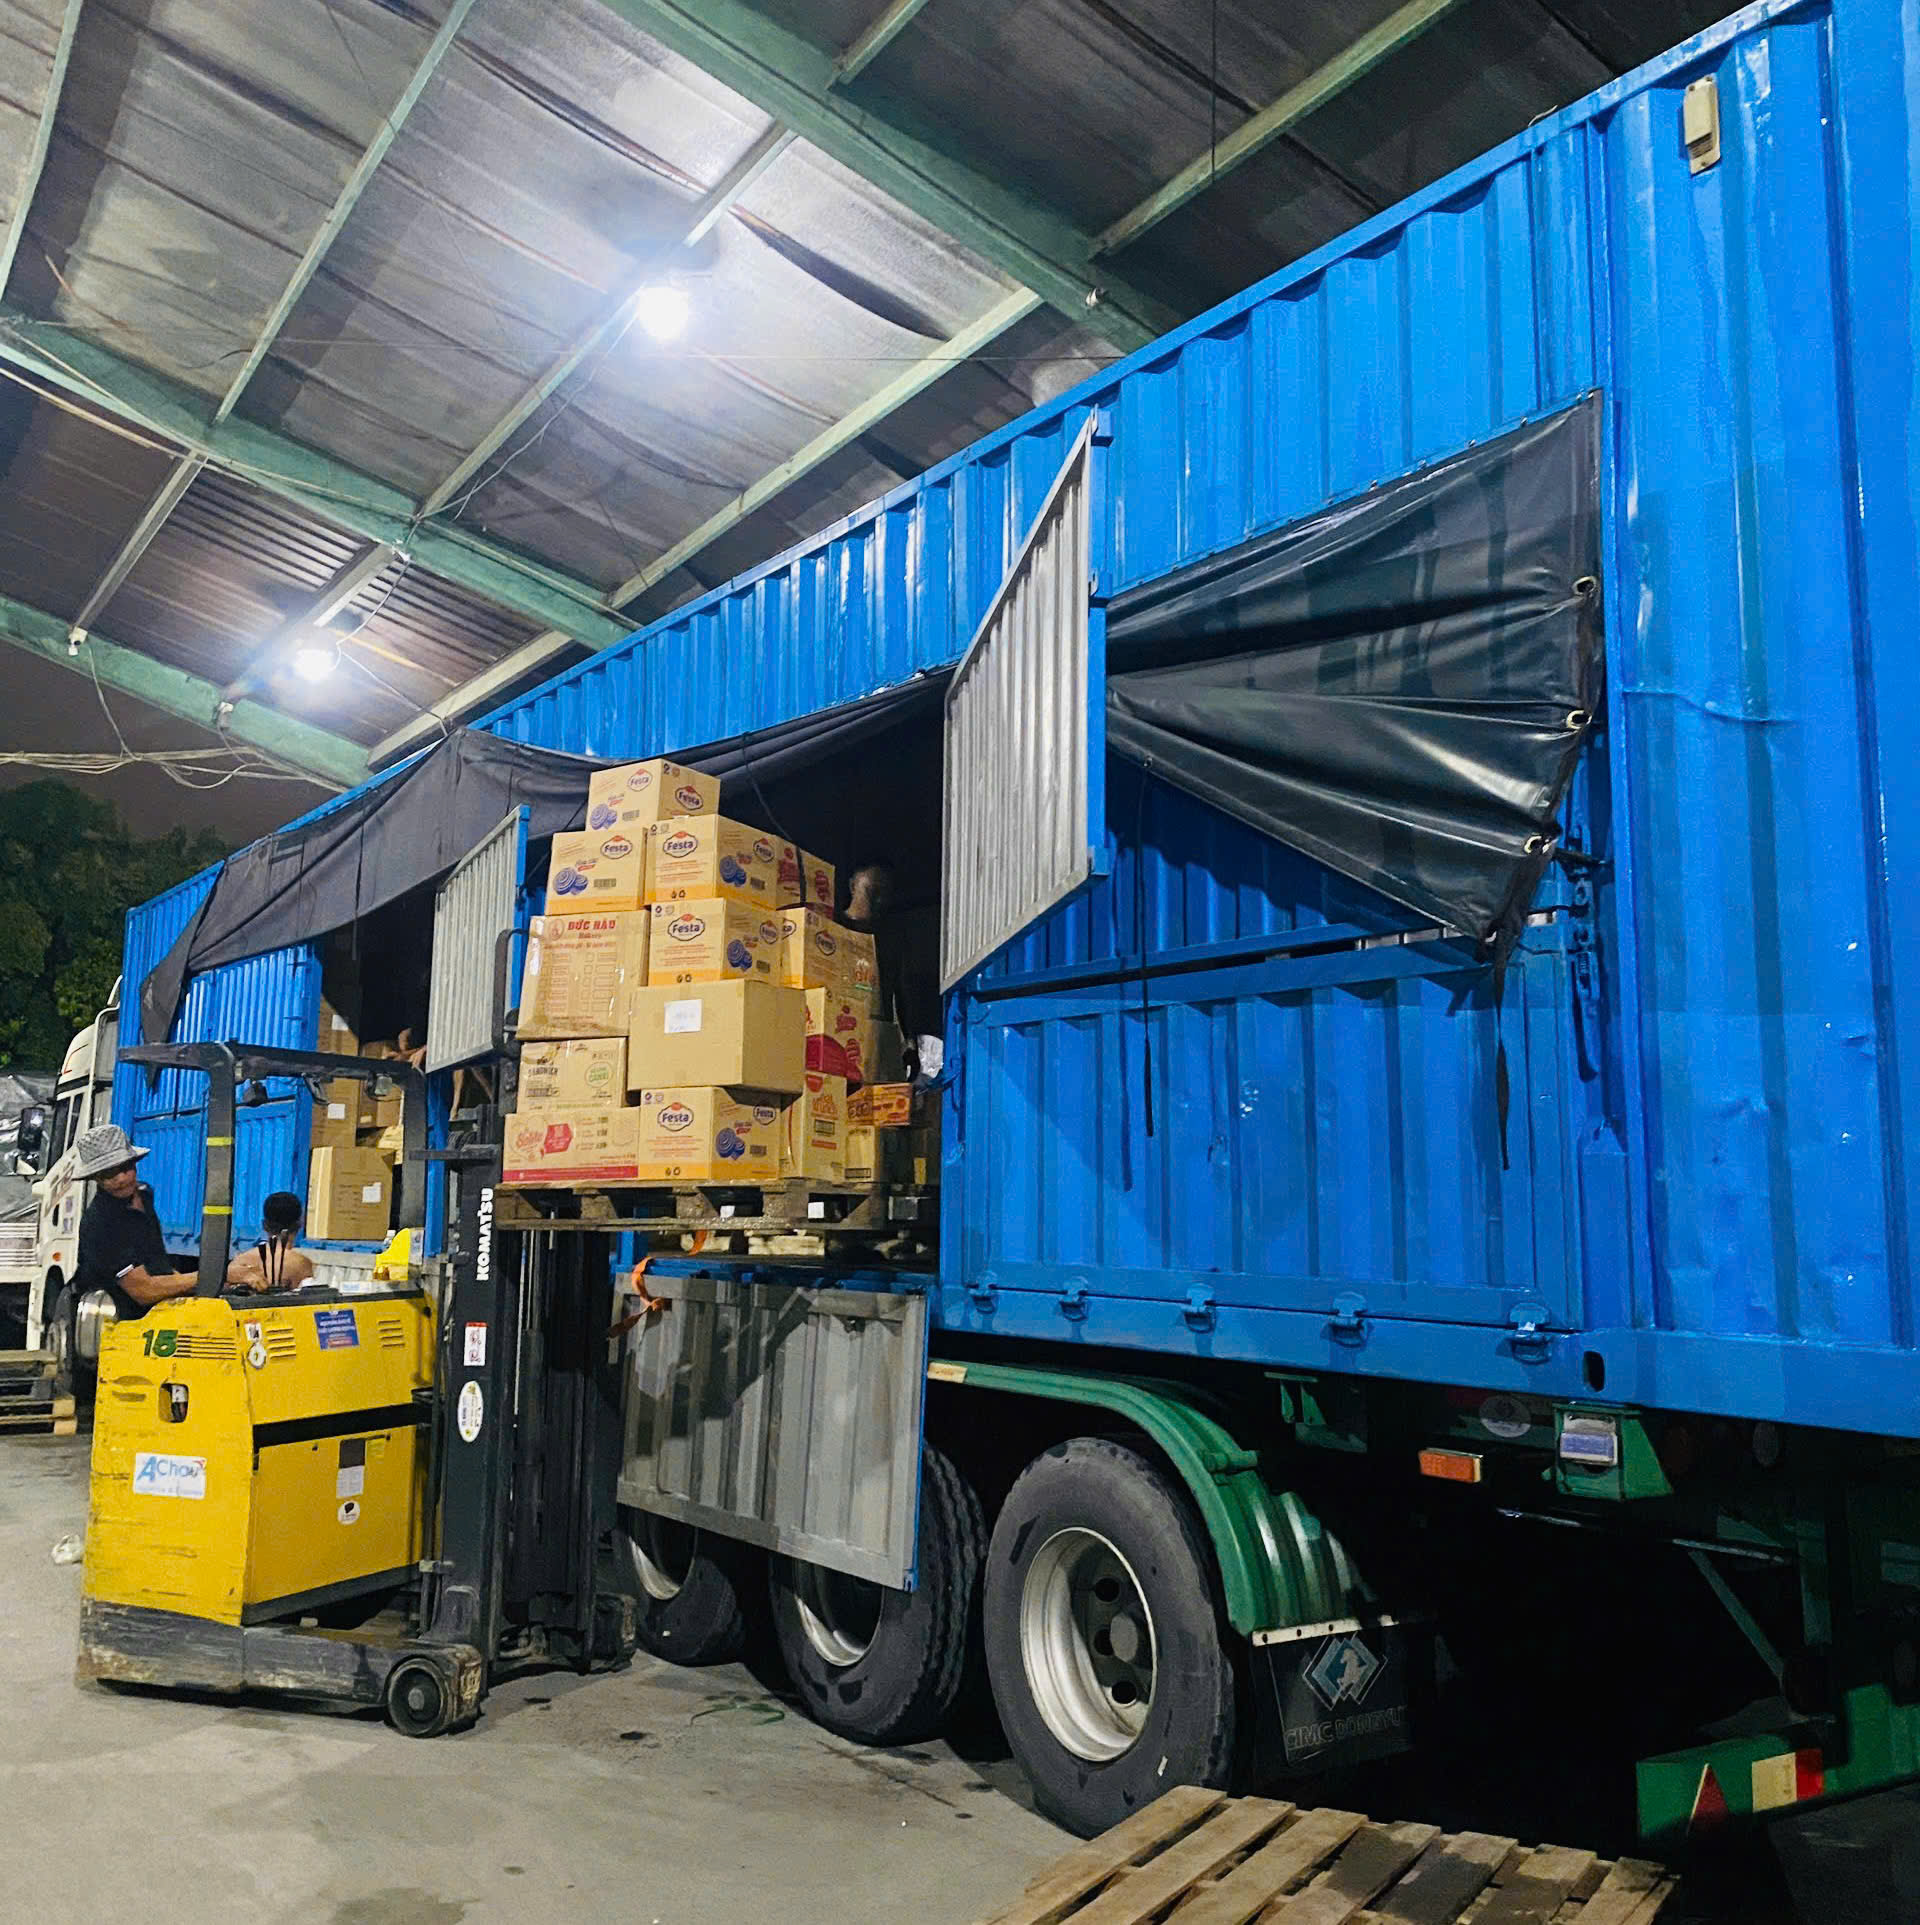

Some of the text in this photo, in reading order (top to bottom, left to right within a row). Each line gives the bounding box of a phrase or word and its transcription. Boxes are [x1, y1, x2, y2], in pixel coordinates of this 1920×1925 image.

[678, 790, 702, 807] Festa
[604, 843, 630, 853] Festa
[666, 840, 694, 851] Festa
[671, 922, 701, 934] Festa
[661, 1111, 690, 1123] Festa
[476, 1187, 494, 1281] KOMATSU
[142, 1329, 179, 1358] 15
